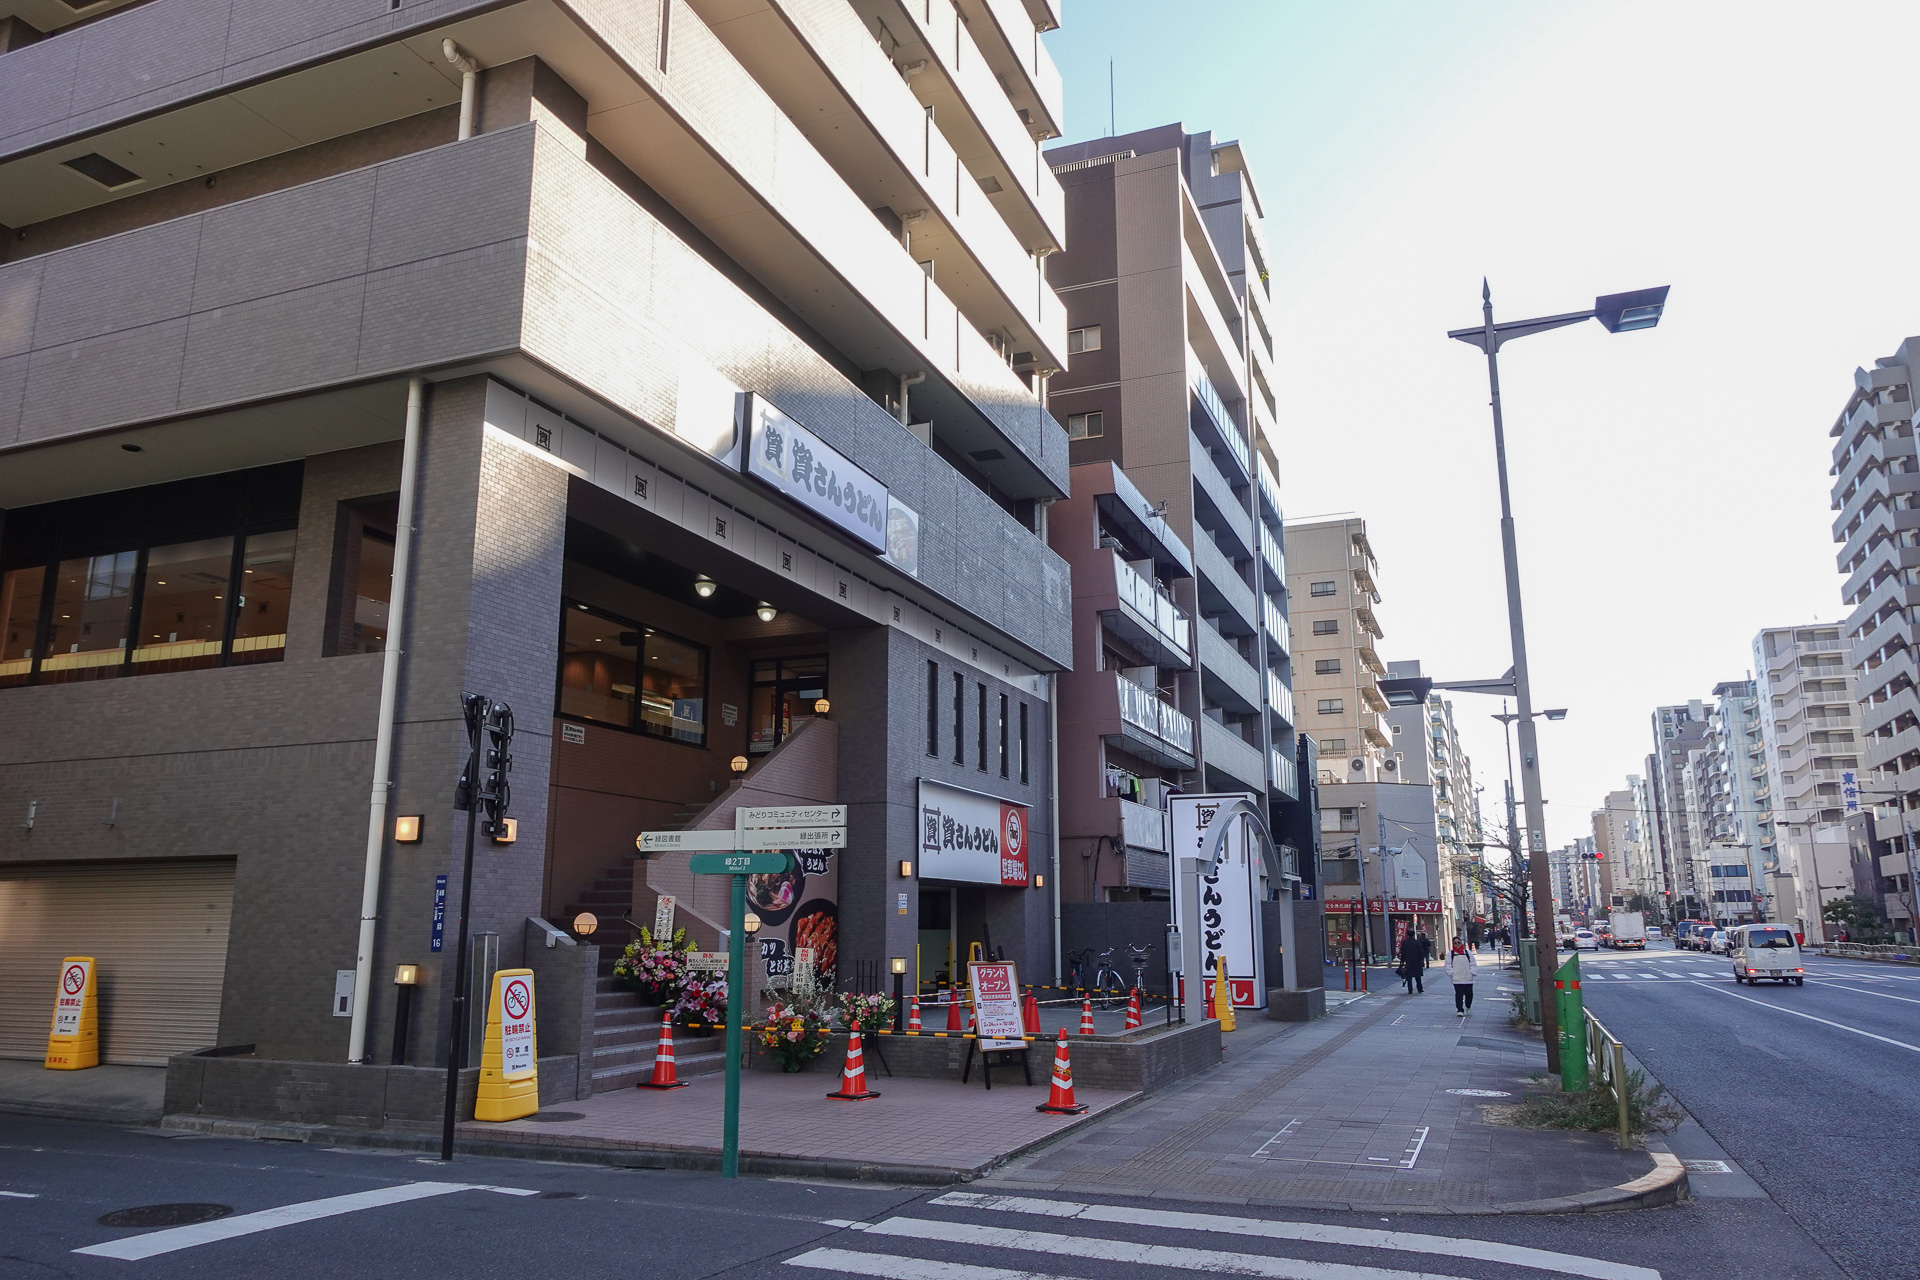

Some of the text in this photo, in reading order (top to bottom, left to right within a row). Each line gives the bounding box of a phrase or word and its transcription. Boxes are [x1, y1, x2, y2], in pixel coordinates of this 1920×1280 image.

[792, 438, 883, 533] 資さんうどん
[1842, 772, 1858, 811] 東信用
[748, 809, 829, 819] みどりコミュニティセンター
[926, 815, 937, 844] 資
[942, 815, 998, 855] 資さんうどん
[654, 834, 682, 843] 緑図書館
[800, 831, 829, 840] 緑出張所
[724, 857, 751, 866] 緑2丁目
[806, 857, 825, 872] うどん
[1002, 858, 1027, 881] 駐車場なし
[437, 889, 445, 931] 緑二丁目
[1397, 901, 1439, 911] 極上ラーメン
[432, 938, 441, 948] 16
[979, 967, 1006, 978] グランド
[980, 980, 1008, 991] オープン
[59, 998, 82, 1007] 駐輪禁止
[504, 1023, 531, 1036] 駐輪禁止
[985, 1027, 1017, 1035] グランドオープン
